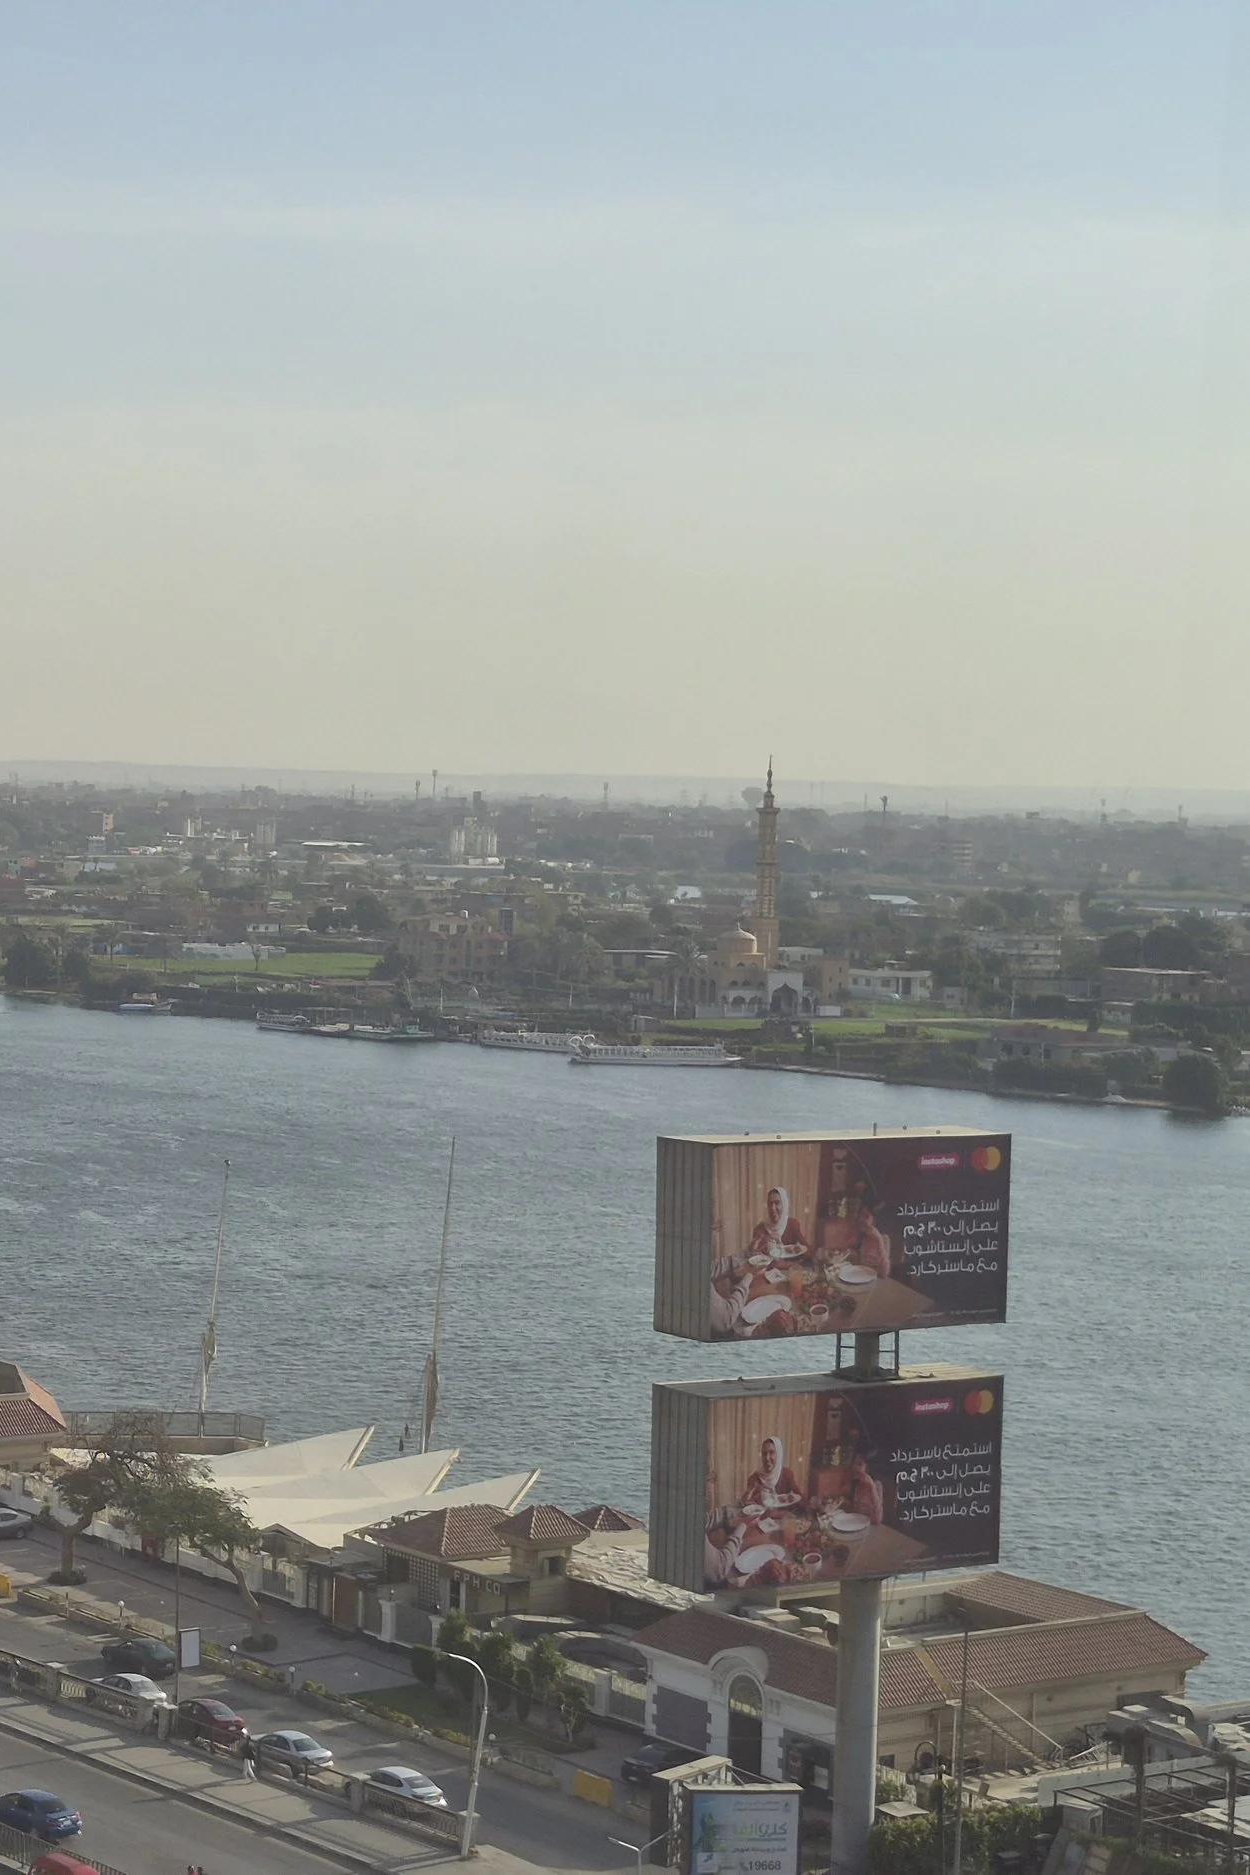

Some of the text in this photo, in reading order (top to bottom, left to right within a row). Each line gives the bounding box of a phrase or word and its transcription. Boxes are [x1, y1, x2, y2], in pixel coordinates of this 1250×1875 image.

[921, 1157, 955, 1166] instashop
[897, 1199, 1000, 1217] استمتع باسترداد
[966, 1219, 999, 1234] يصل
[904, 1238, 999, 1257] على إنستاشوب
[976, 1257, 998, 1273] مع
[890, 1441, 992, 1463] استمتع باسترداد
[958, 1462, 991, 1478] يصل
[897, 1480, 990, 1503] على إنستاشوب
[969, 1501, 990, 1517] مع
[748, 1860, 782, 1871] 19668
